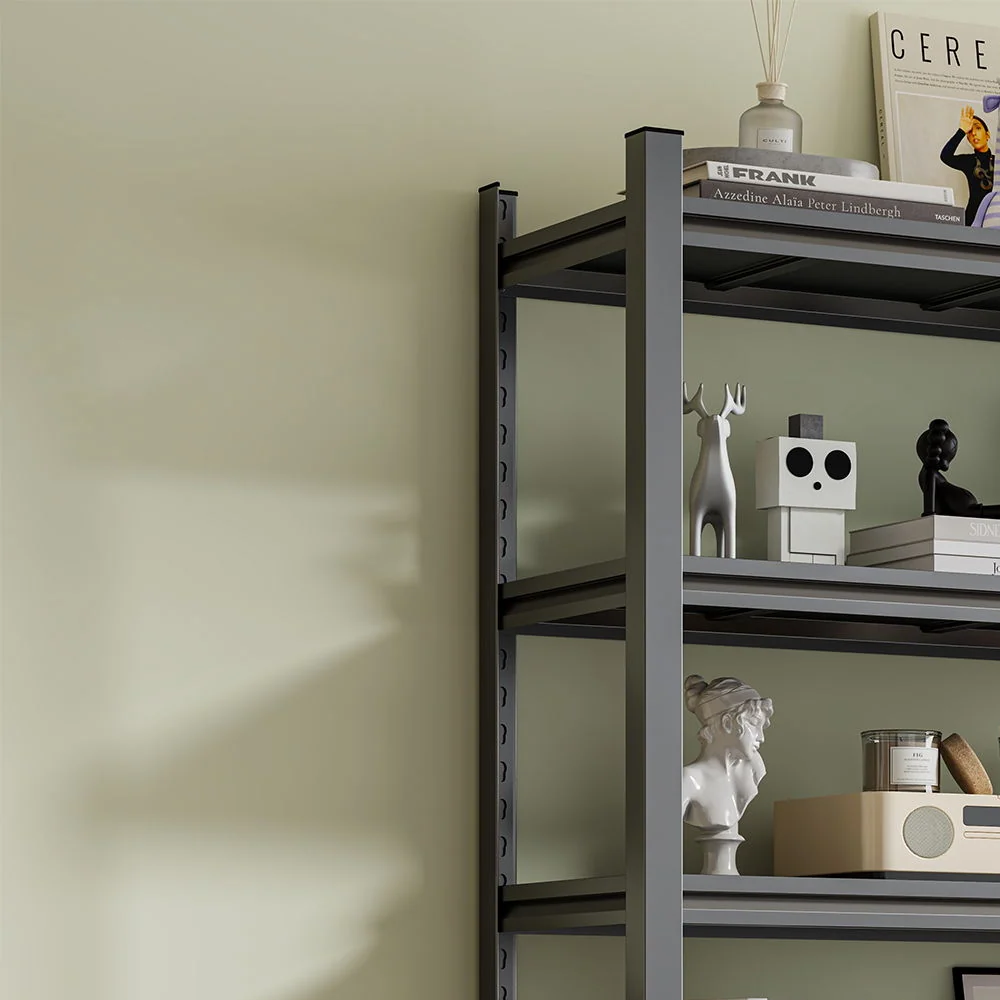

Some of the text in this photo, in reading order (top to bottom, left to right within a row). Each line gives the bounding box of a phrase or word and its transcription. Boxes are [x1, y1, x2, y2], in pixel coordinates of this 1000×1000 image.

[732, 167, 817, 187] FRANK
[713, 188, 901, 219] Azzedine Alaïa Peter Lindbergh
[934, 214, 961, 223] TASCHEN
